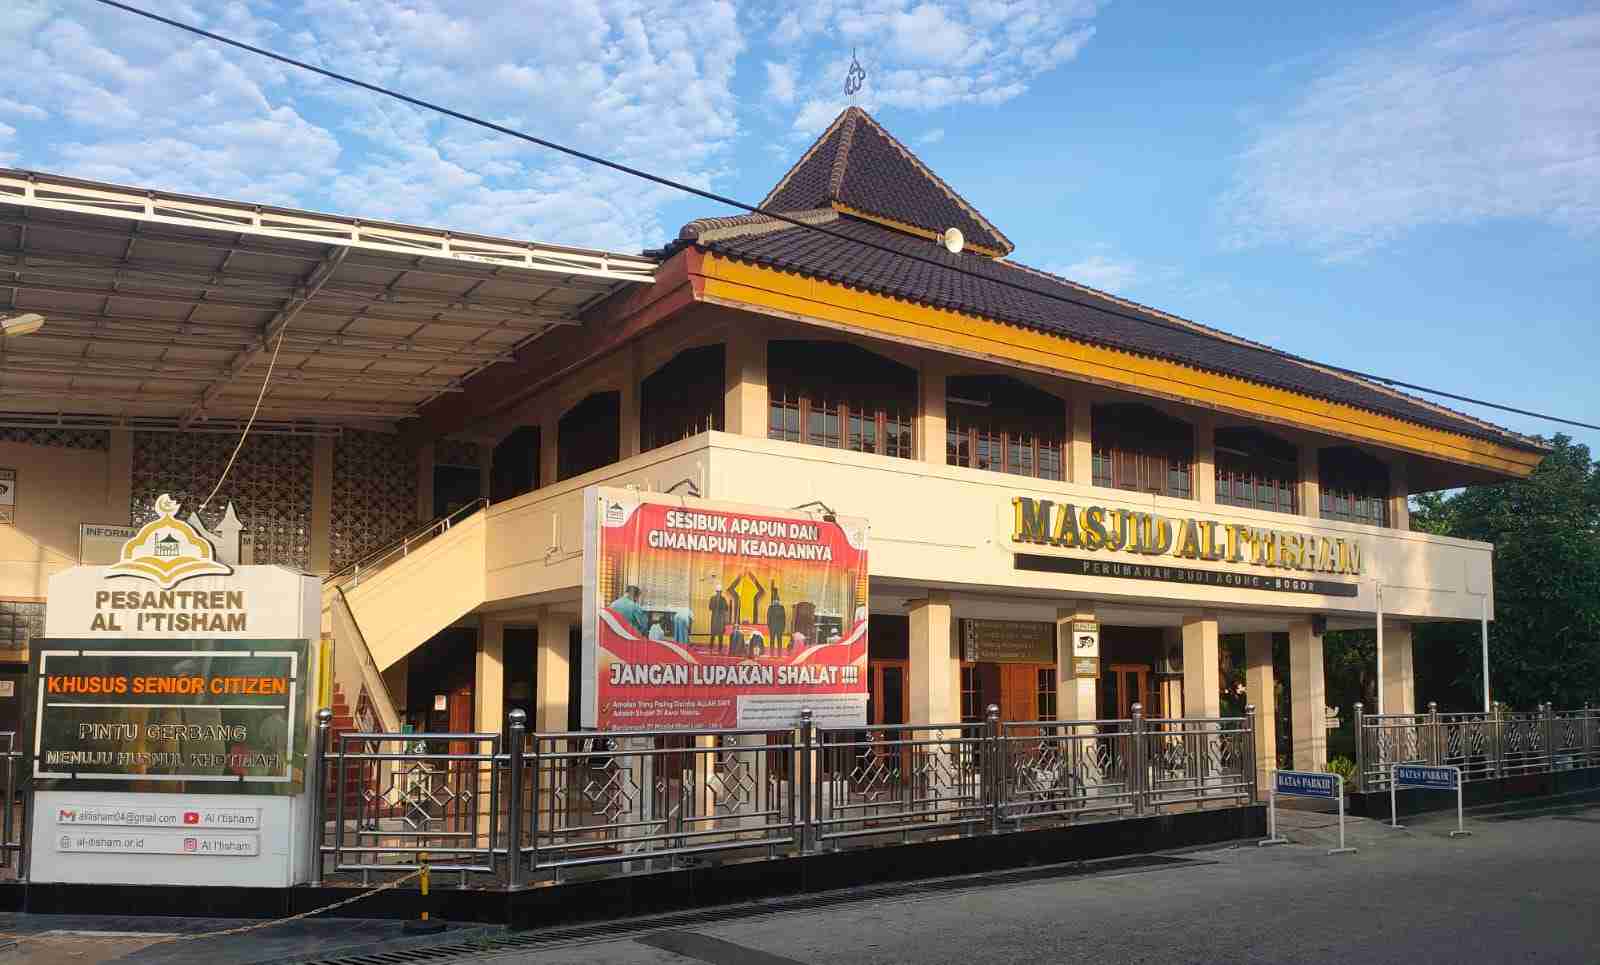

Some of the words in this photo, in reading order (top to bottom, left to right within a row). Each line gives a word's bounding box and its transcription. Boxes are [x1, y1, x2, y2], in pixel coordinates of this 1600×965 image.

[666, 510, 728, 533] SESIBUK
[730, 518, 787, 538] APAPUN
[789, 524, 818, 541] DAN
[649, 530, 737, 555] GIMANAPUN
[740, 538, 833, 561] KEADAANNYA
[1012, 497, 1172, 555] MASJID
[1173, 517, 1225, 561] AL
[1224, 524, 1361, 576] I'TISHAM
[1082, 560, 1170, 580] PERUMAHAN
[1176, 568, 1210, 584] BUDI
[1216, 574, 1260, 588] AGUNG
[1275, 583, 1315, 592] BOGOR
[95, 590, 243, 610] PESANTREN
[90, 612, 122, 631] AL
[137, 612, 247, 632] I'TISHAM
[47, 675, 128, 694] KHUSUS
[131, 676, 205, 695] SENIOR
[209, 677, 288, 695] CITIZEN
[610, 663, 688, 686] JANGAN
[693, 663, 773, 685] LUPAKAN
[777, 664, 838, 685] SHALAT
[79, 723, 138, 741] PINTU
[146, 724, 249, 742] GERBANG
[45, 750, 113, 766] MENUJU
